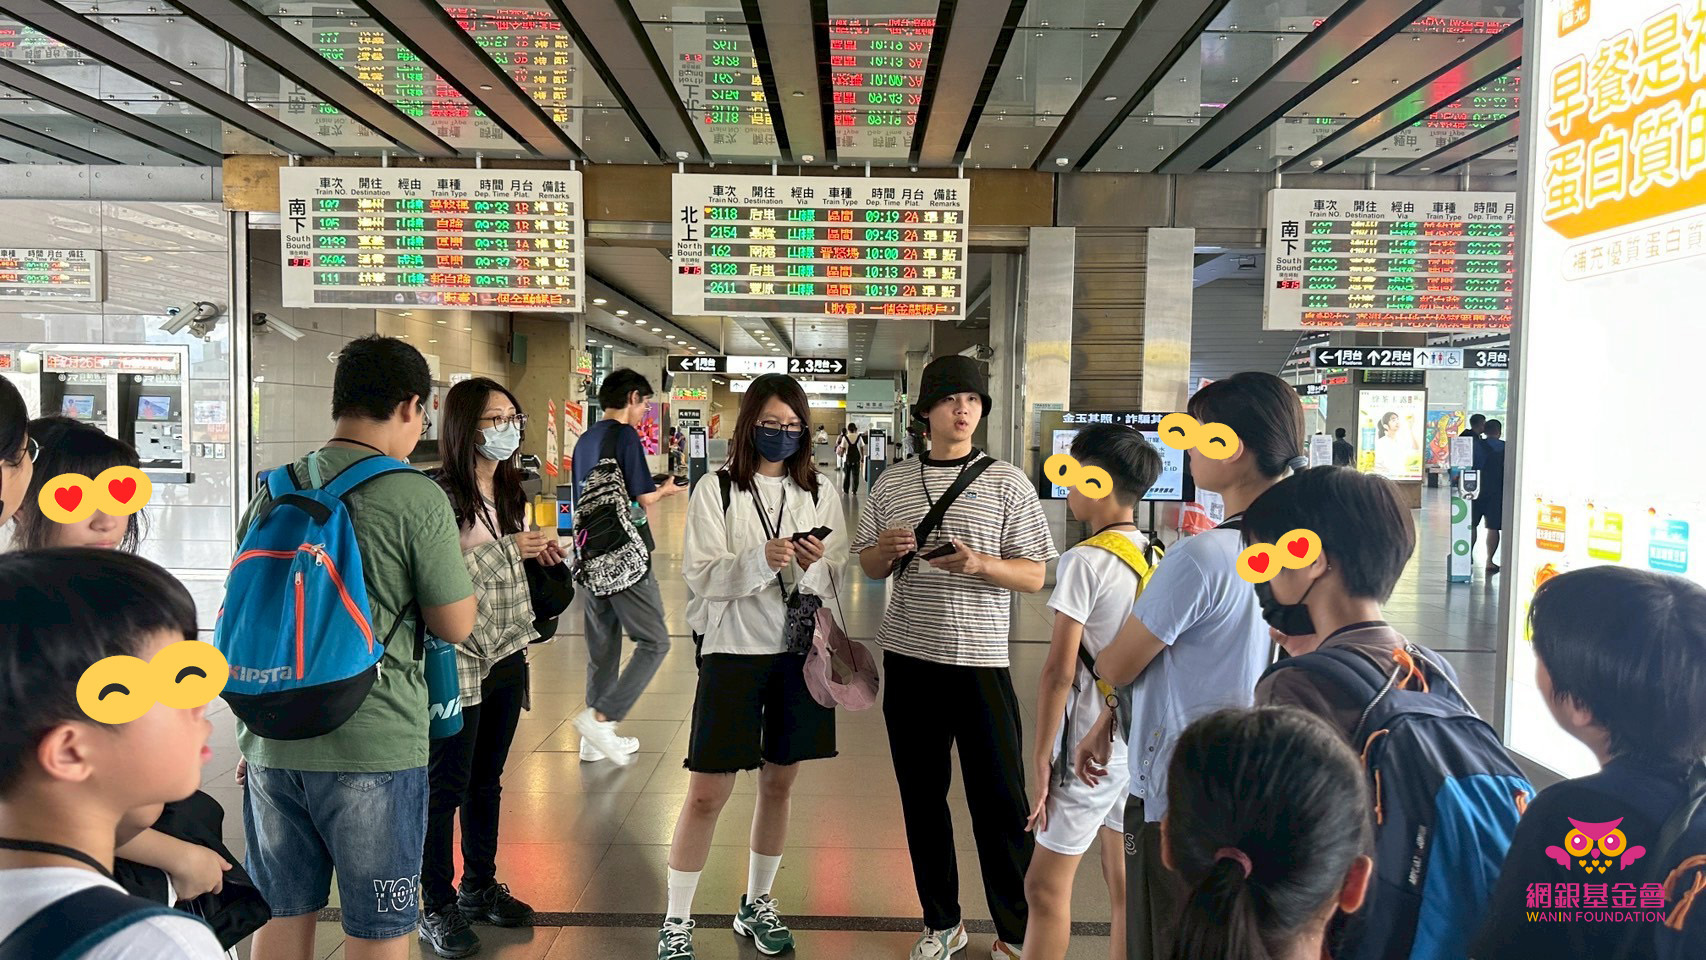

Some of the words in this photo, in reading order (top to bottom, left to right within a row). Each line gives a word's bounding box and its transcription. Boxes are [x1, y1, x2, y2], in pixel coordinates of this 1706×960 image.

[319, 177, 344, 189] 車次
[359, 178, 382, 189] 開往
[398, 178, 421, 190] 經由
[437, 178, 461, 190] 車種
[480, 179, 504, 191] 時間
[510, 179, 533, 192] 月台
[542, 181, 566, 193] 備註
[450, 190, 468, 198] Type
[713, 185, 736, 197] 車次
[752, 186, 775, 198] 開往
[791, 187, 814, 198] 經由
[829, 187, 852, 198] 車種
[872, 188, 895, 199] 時間
[902, 189, 924, 200] 月台
[934, 189, 957, 201] 備註
[744, 197, 783, 205] Destination
[1314, 200, 1337, 211] 車次
[1353, 201, 1377, 212] 開往
[1391, 202, 1414, 213] 經由
[1433, 202, 1456, 213] 車種
[1474, 203, 1498, 213] 時間
[289, 199, 306, 233] 南下
[710, 208, 737, 220] 3118
[828, 211, 853, 222] 區間
[865, 211, 900, 223] 09:19
[904, 211, 919, 223] 2A
[681, 206, 698, 242] 北上
[710, 226, 737, 238] 2154
[828, 229, 853, 240] 區間
[865, 229, 899, 241] 09:43
[904, 230, 918, 241] 2A
[1281, 220, 1298, 256] 南下
[677, 249, 702, 257] Bound
[711, 245, 731, 257] 162
[865, 248, 898, 259] 10:00
[904, 248, 918, 260] 2A
[710, 264, 737, 275] 3128
[827, 266, 852, 277] 區間
[865, 266, 898, 278] 10:13
[903, 267, 917, 278] 2A
[710, 282, 736, 293] 2611
[827, 284, 852, 296] 區間
[865, 285, 897, 296] 10:19
[903, 285, 916, 297] 2A
